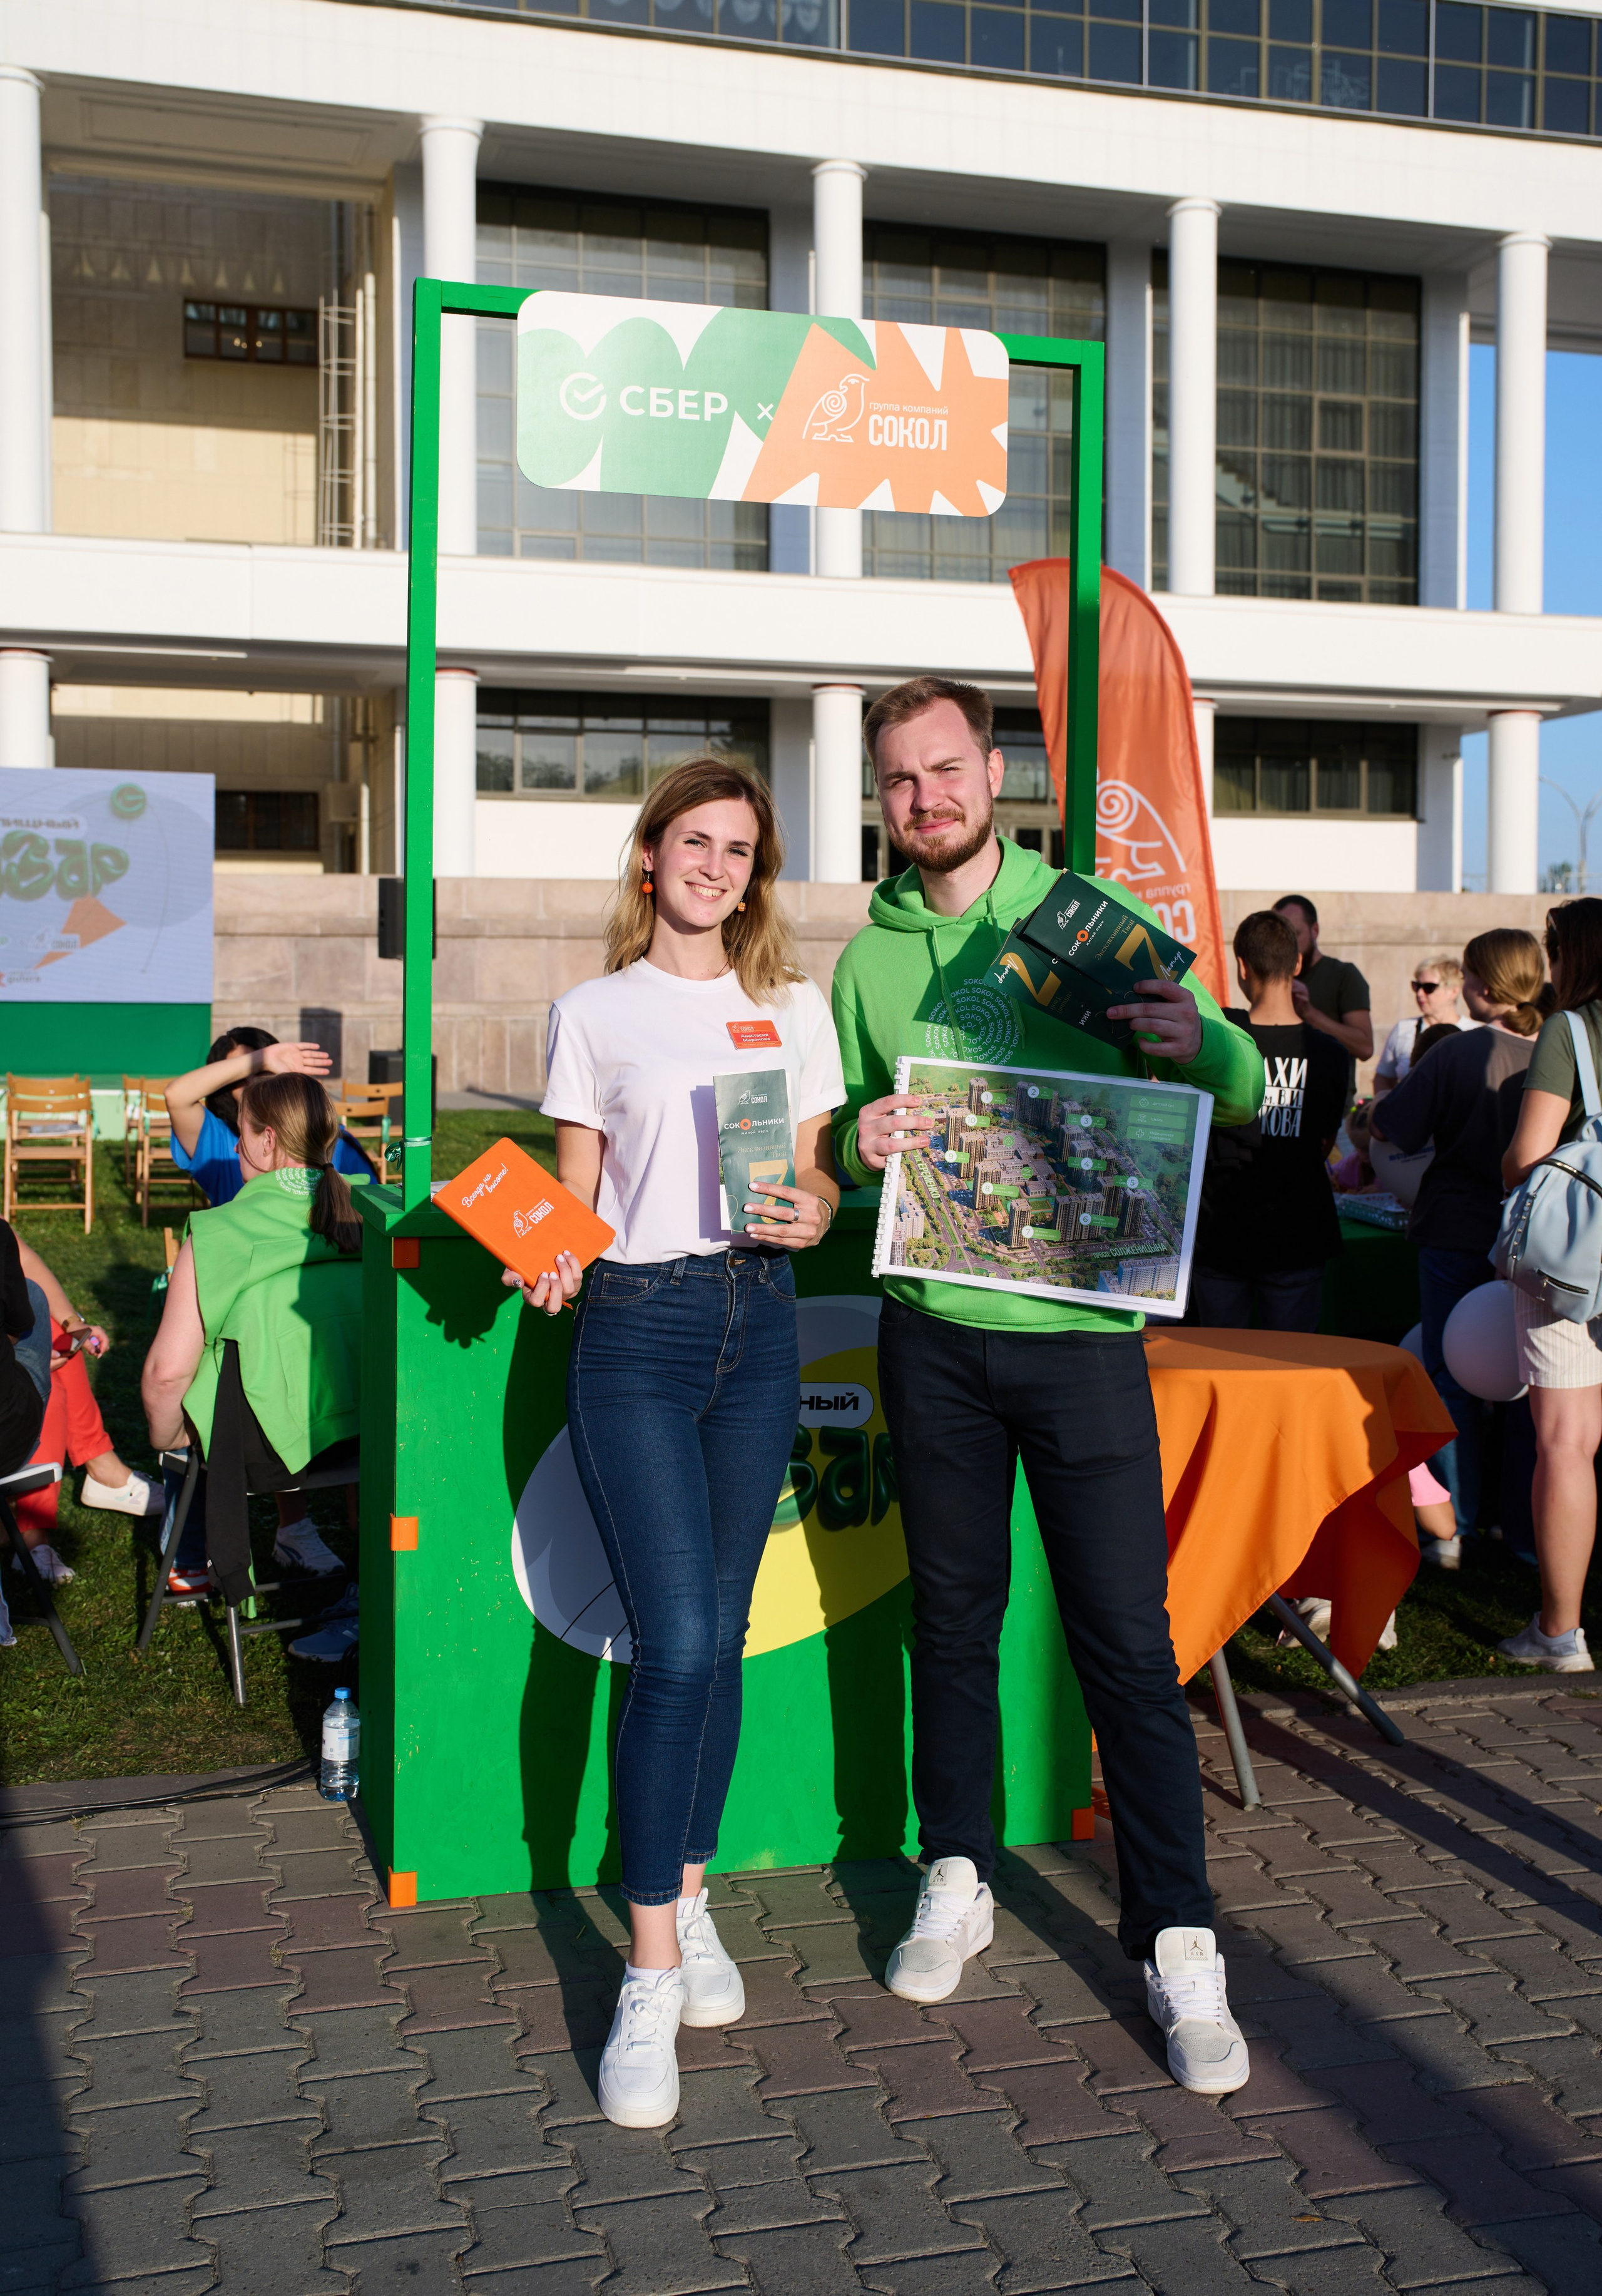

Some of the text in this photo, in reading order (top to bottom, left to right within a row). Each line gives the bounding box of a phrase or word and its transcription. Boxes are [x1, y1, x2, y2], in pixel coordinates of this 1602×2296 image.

[620, 385, 728, 421] СБЕР
[869, 402, 949, 416] группа компаний
[869, 414, 947, 451] СОКОЛ
[1066, 900, 1081, 918] СОКОЛ
[1068, 900, 1108, 956] СОКОЛЬНИКИ
[1094, 915, 1128, 960] Эксклюзивный
[1096, 921, 1105, 931] парк
[1121, 919, 1135, 934] Твой
[929, 1000, 946, 1022] SOKOL
[964, 978, 987, 987] SOKO
[956, 995, 980, 1005] SOKOL
[981, 998, 1000, 1018] SOKOL
[933, 1025, 941, 1050] SOKOL
[951, 988, 970, 998] OKOL
[971, 988, 994, 1000] SOKOL
[994, 997, 1010, 1020] SOKOL
[1002, 1020, 1012, 1045] SOKOL
[955, 1005, 970, 1014] KOL
[971, 1005, 991, 1022] SOKOL
[982, 1022, 994, 1045] SOKOL
[960, 1013, 986, 1044] SOKOL SOKOL
[993, 1018, 1003, 1043] SOKOL
[941, 1022, 950, 1047] SOKOL
[974, 1044, 996, 1062] SOKOL
[998, 1050, 1013, 1066] SOKO
[751, 1095, 768, 1104] СОКОЛ
[724, 1118, 784, 1130] СОКОЛЬНИКИ
[1258, 1105, 1302, 1137] КОВА
[738, 1143, 786, 1153] Эксклюзивный
[485, 1162, 509, 1193] высоте!
[917, 1163, 941, 1198] ЕРЕМЕНКО
[461, 1174, 492, 1207] Всегда на
[529, 1201, 554, 1224] СОКОЛ
[1110, 1243, 1168, 1256] СОЛЖЕНИЦЫНА
[800, 1392, 859, 1410] НЫЙ
